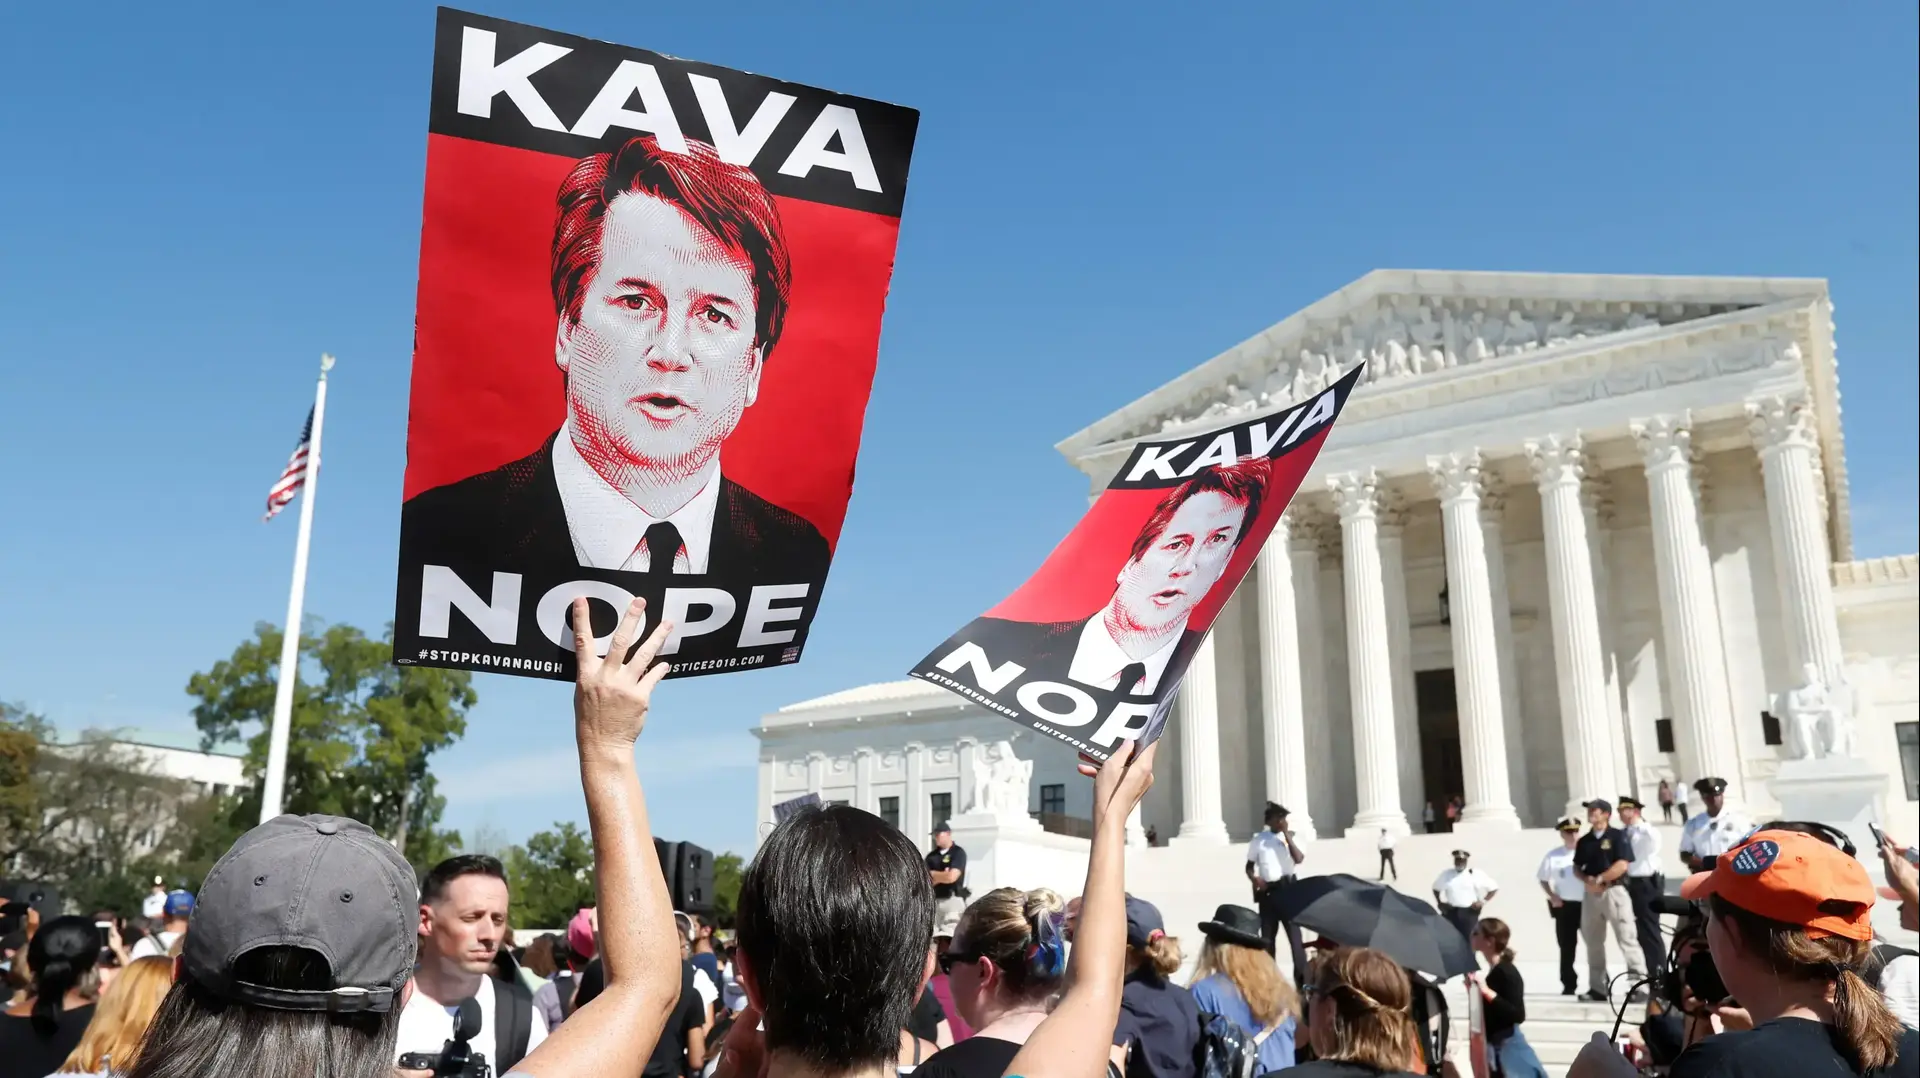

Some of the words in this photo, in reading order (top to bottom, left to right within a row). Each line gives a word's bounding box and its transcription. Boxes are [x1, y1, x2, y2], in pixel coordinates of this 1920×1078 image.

[457, 26, 883, 193] KAVA
[1125, 388, 1335, 481] KAVA
[418, 564, 810, 656] NOPE
[418, 649, 563, 673] #STOPKAVANAUGH
[935, 641, 1158, 748] NOP
[1033, 721, 1109, 760] UNITEFORJUS
[1749, 843, 1767, 865] NRA
